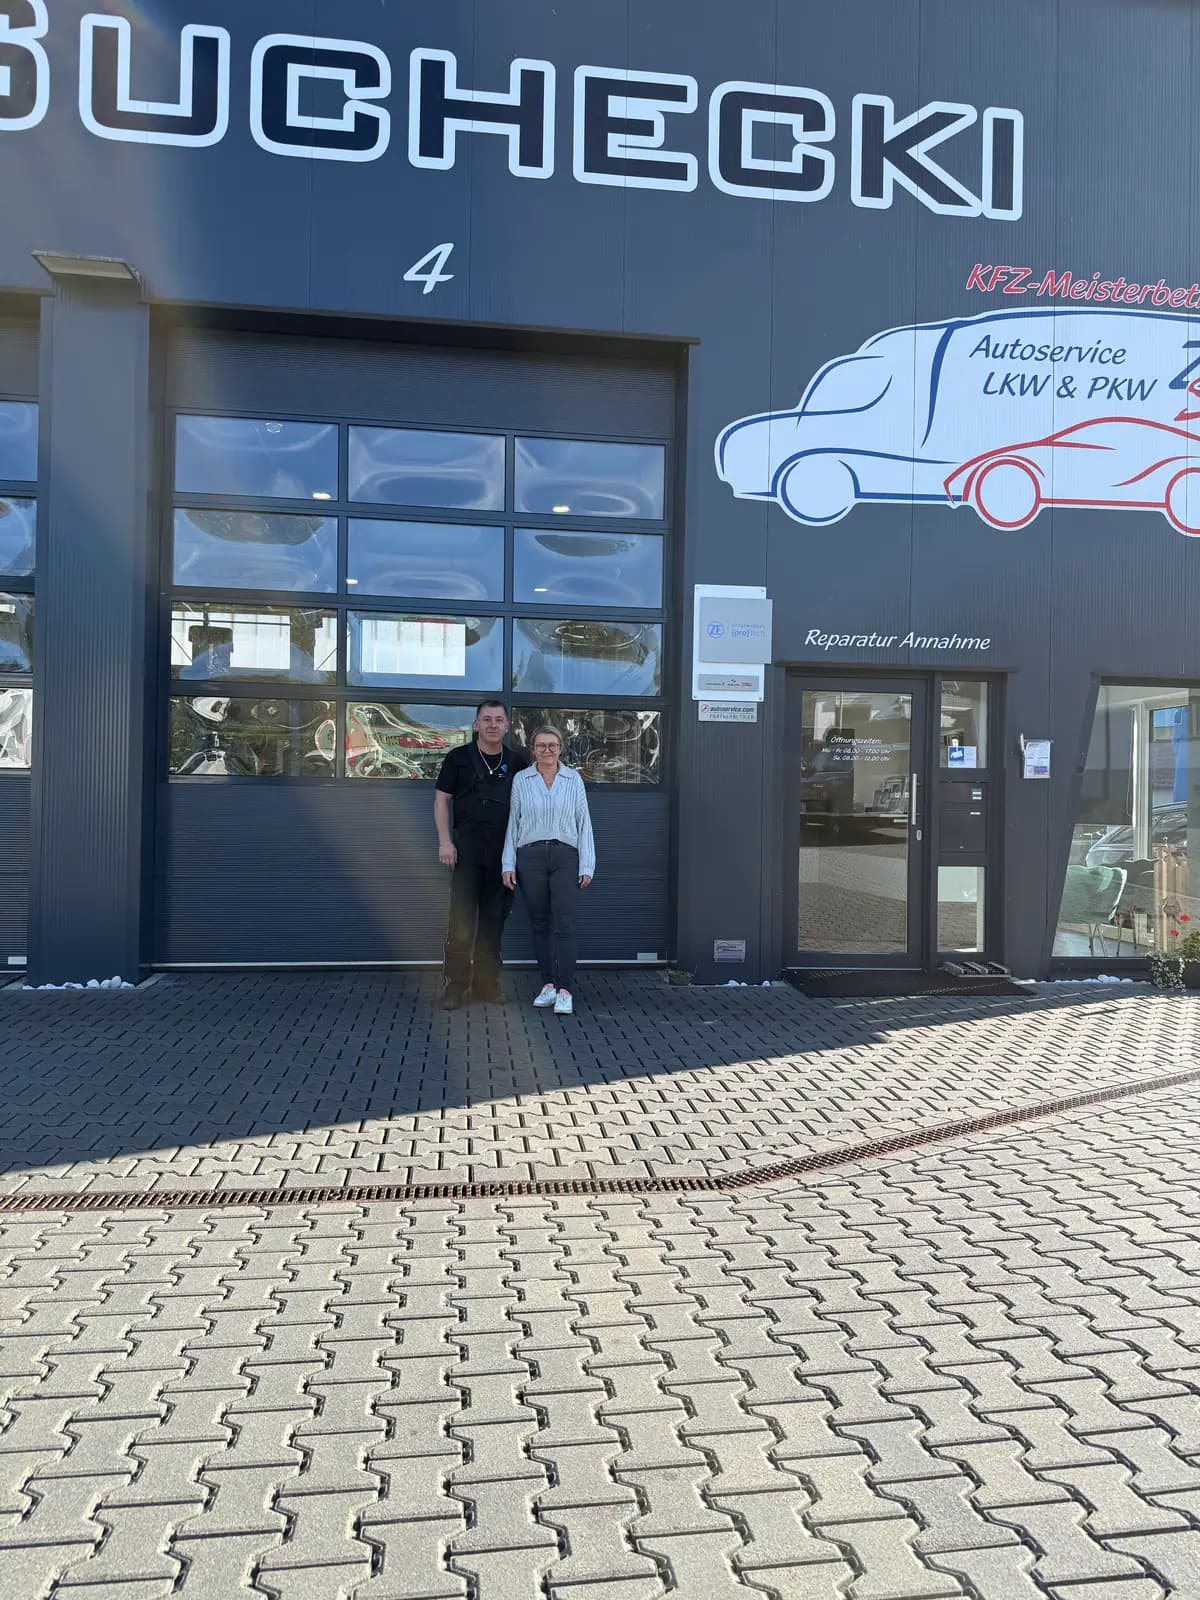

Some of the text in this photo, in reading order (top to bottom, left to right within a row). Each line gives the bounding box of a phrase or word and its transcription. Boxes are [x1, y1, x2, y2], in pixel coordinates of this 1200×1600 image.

[403, 242, 455, 295] 4
[966, 263, 1200, 309] KFZ-Meisterbet
[969, 334, 1127, 365] Autoservice
[982, 371, 1158, 401] LKW & PKW
[804, 629, 991, 650] Reparatur Annahme
